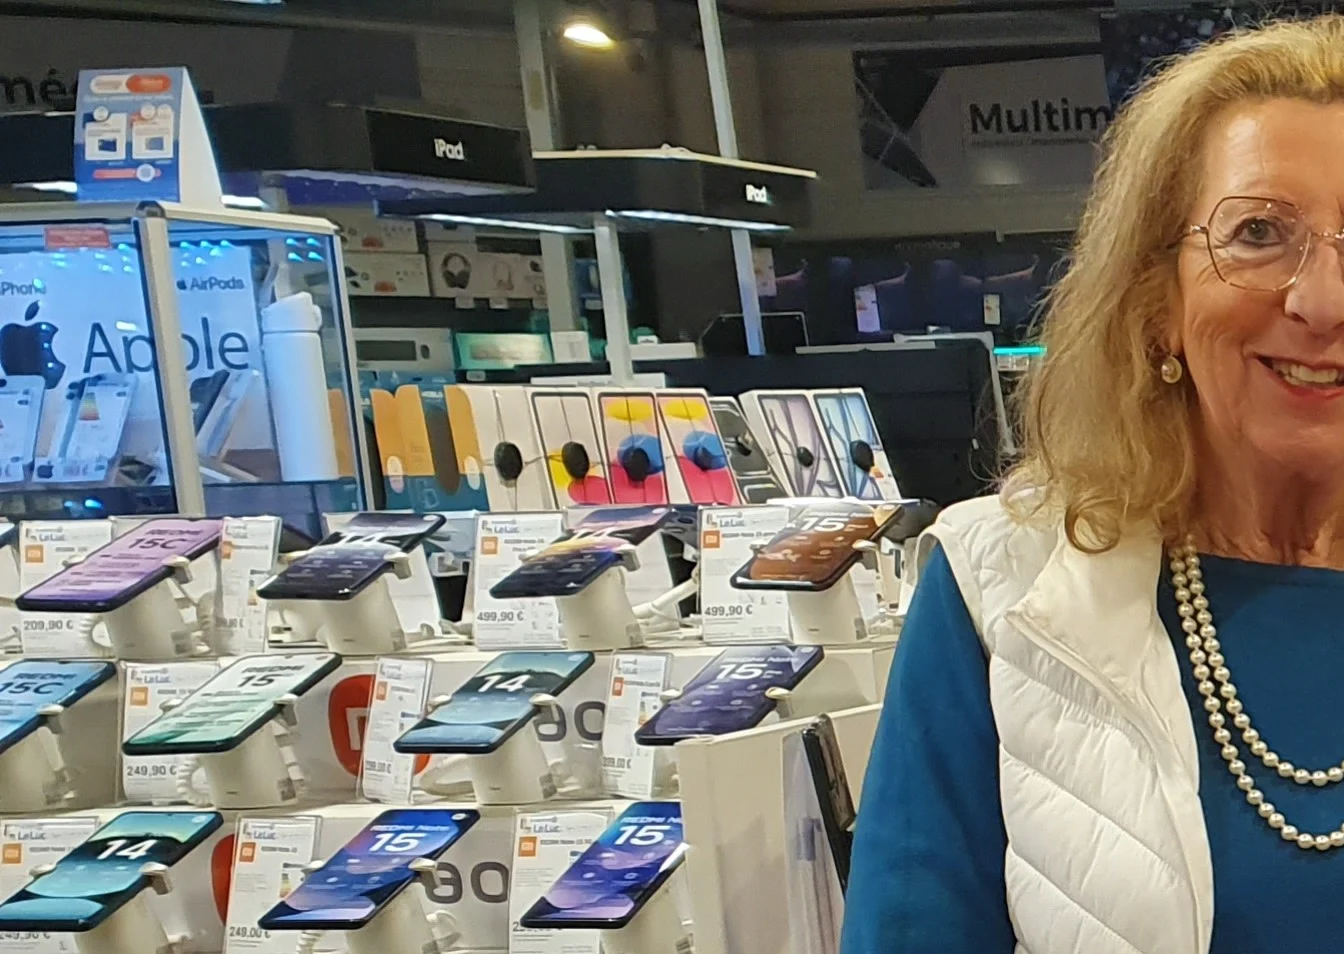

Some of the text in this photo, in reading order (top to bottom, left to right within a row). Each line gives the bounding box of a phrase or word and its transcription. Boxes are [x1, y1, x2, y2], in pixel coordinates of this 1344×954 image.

[969, 98, 1112, 134] Multim
[434, 139, 465, 160] iPad
[190, 277, 244, 292] AirPods
[799, 517, 851, 532] 15
[128, 538, 186, 549] 15C
[237, 674, 280, 687] 15
[714, 663, 768, 680] 15
[477, 674, 528, 693] 14
[368, 833, 428, 852] 15
[614, 825, 671, 846] 15
[97, 839, 157, 860] 14
